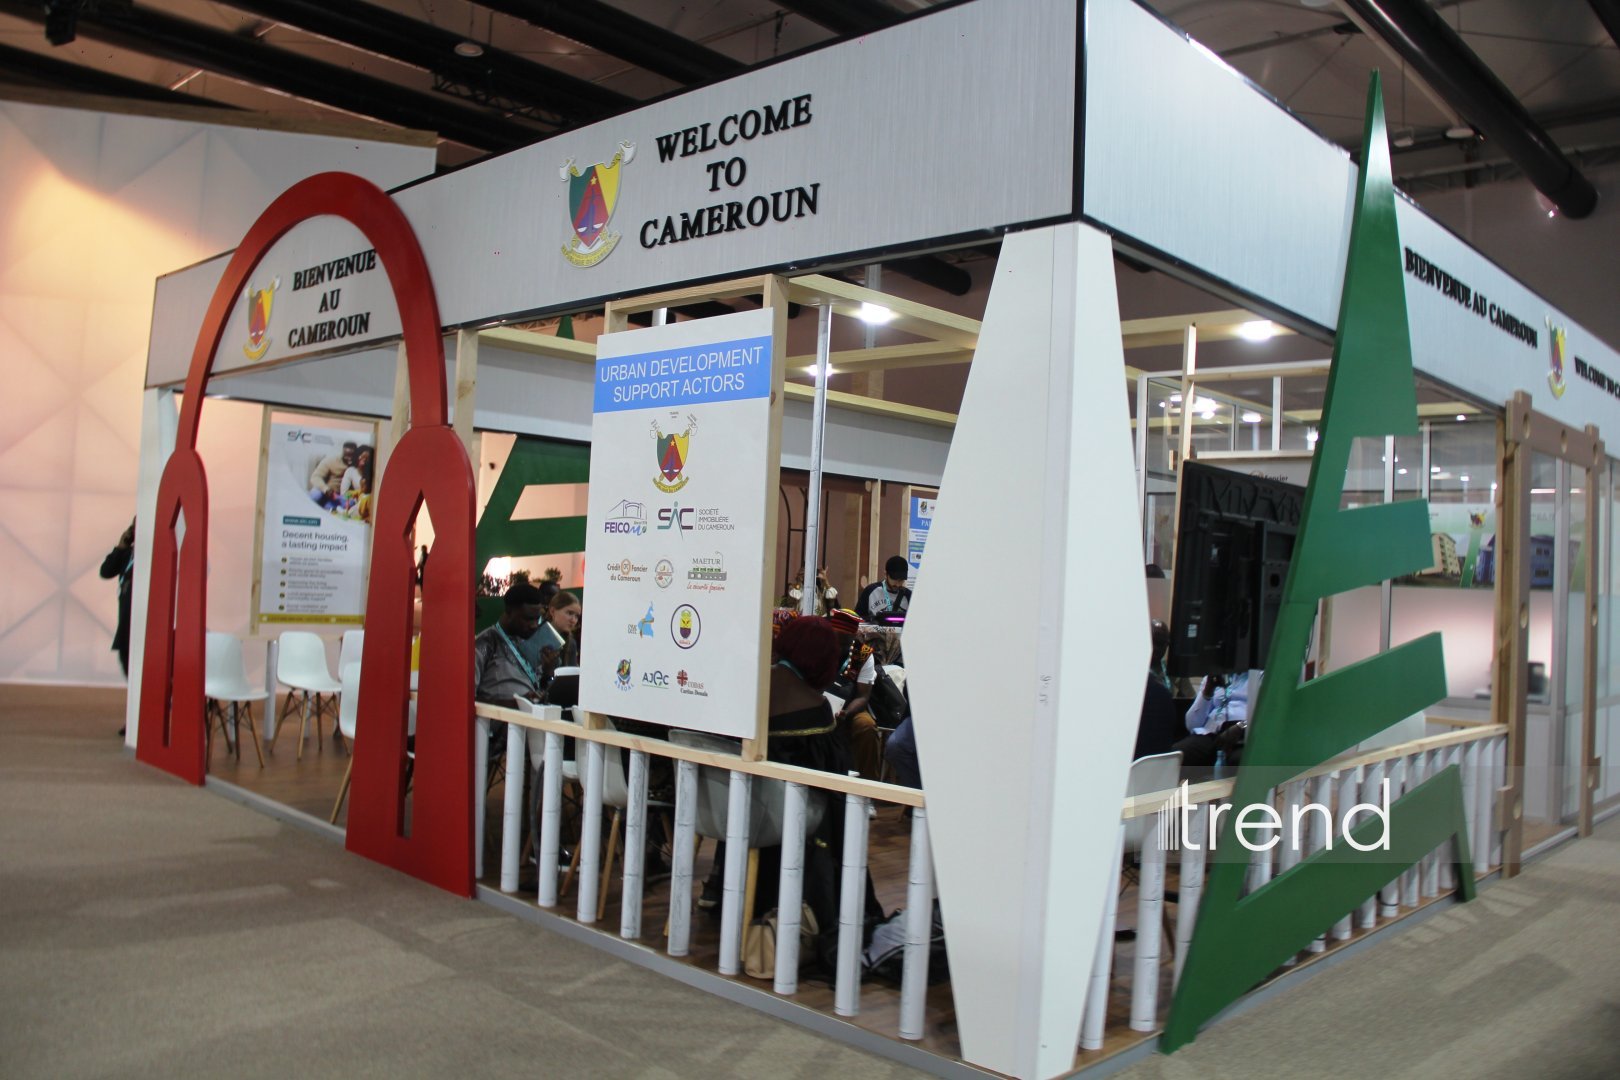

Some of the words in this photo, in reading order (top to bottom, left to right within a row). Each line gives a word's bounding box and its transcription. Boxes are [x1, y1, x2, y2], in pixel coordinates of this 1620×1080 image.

[656, 93, 812, 163] WELCOME
[706, 156, 747, 192] TO
[639, 183, 820, 249] CAMEROUN
[292, 249, 376, 291] BIENVENUE
[318, 288, 341, 314] AU
[1405, 246, 1472, 309] BIENVENUE
[1473, 291, 1488, 318] AU
[1489, 303, 1538, 349] CAMEROUN
[288, 312, 371, 349] CAMEROUN
[601, 361, 647, 383] URBAN
[650, 346, 764, 377] DEVELOPMENT
[613, 379, 680, 403] SUPPORT
[681, 372, 745, 396] ACTORS
[282, 530, 313, 541] Decent
[289, 540, 318, 552] lasting
[320, 543, 349, 553] impact
